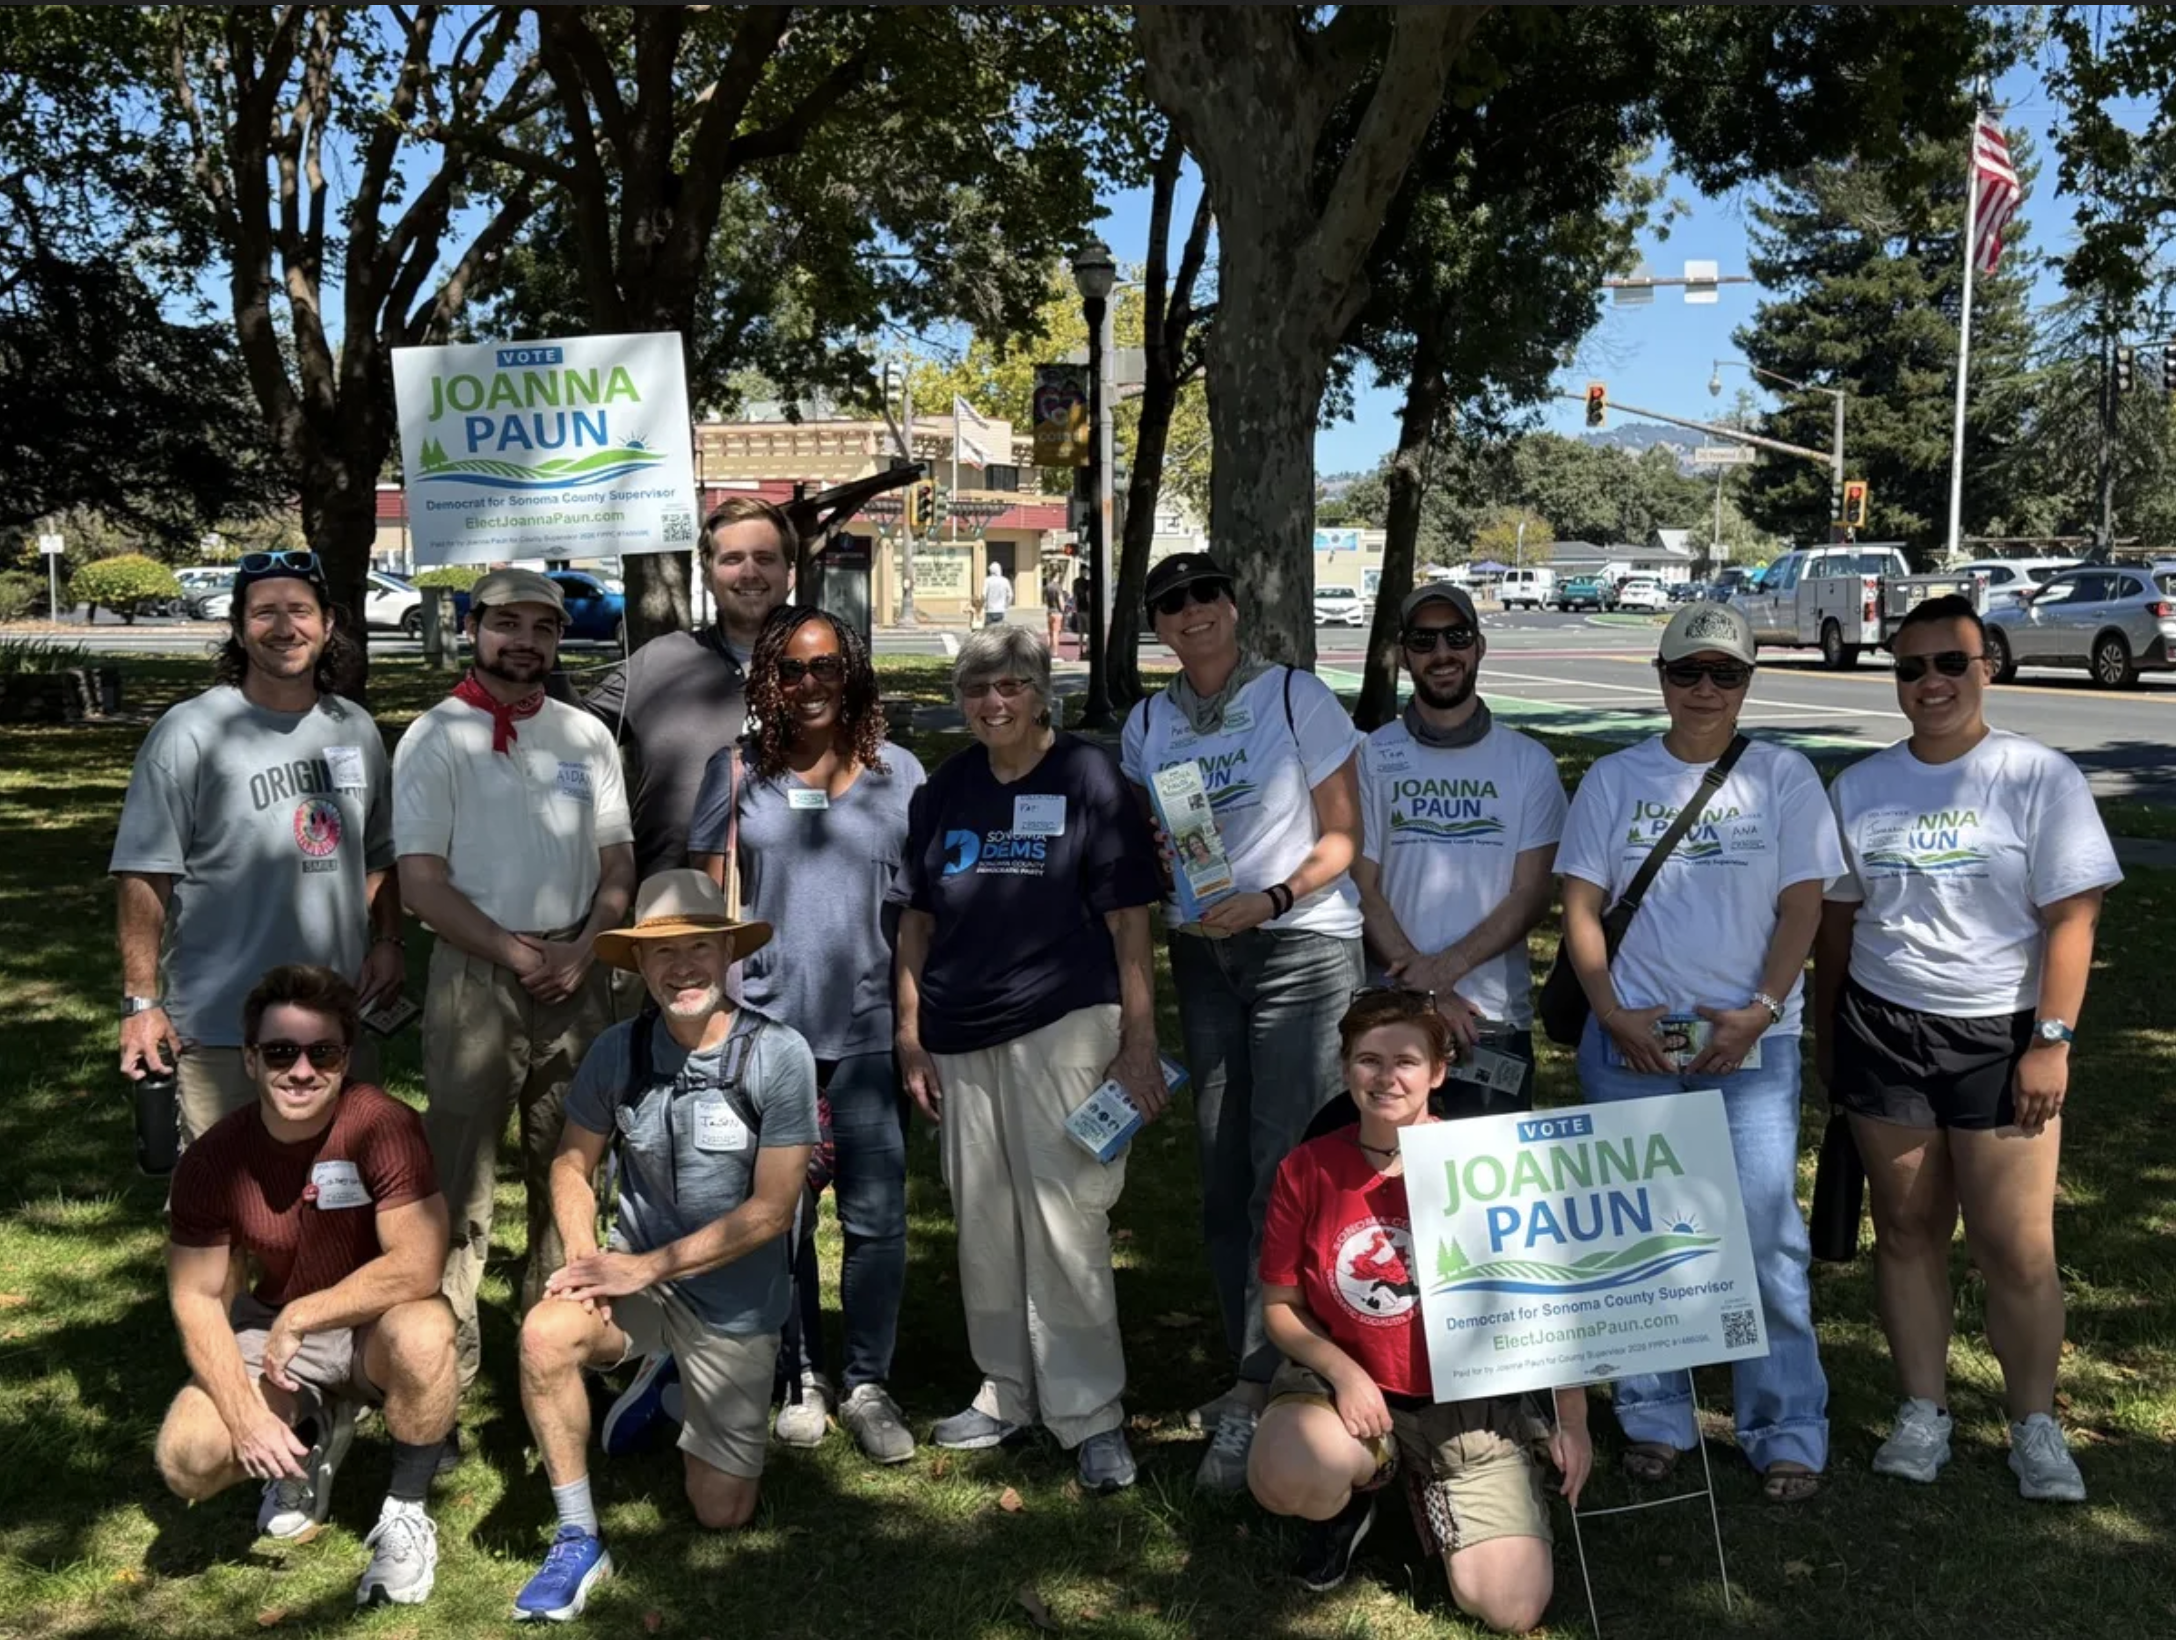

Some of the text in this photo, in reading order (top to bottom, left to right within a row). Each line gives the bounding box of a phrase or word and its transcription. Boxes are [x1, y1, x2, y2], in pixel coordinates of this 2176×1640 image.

[502, 350, 556, 364] VOTE
[428, 366, 641, 421] JOANNA
[466, 411, 608, 452] PAUN
[426, 489, 676, 510] Democrat for Sonoma County Supervisor
[465, 511, 625, 529] ElectJoannaPaun.com
[1391, 778, 1499, 804] JOANNA
[1411, 797, 1482, 819] PAUN
[982, 841, 1046, 859] DEMS
[1523, 1118, 1585, 1140] VOTE
[1443, 1132, 1685, 1217] JOANNA
[1332, 1216, 1387, 1251] SONOMA
[1486, 1187, 1653, 1253] PAUN
[1446, 1280, 1734, 1330] Democrat for Sonoma County Supervisor
[1493, 1314, 1679, 1351] ElectJoannaPaun.com
[1453, 1368, 1470, 1378] Paid
[1496, 1362, 1523, 1373] Joanna
[1524, 1359, 1545, 1369] Paun
[1546, 1356, 1556, 1365] for
[1558, 1351, 1585, 1364] County
